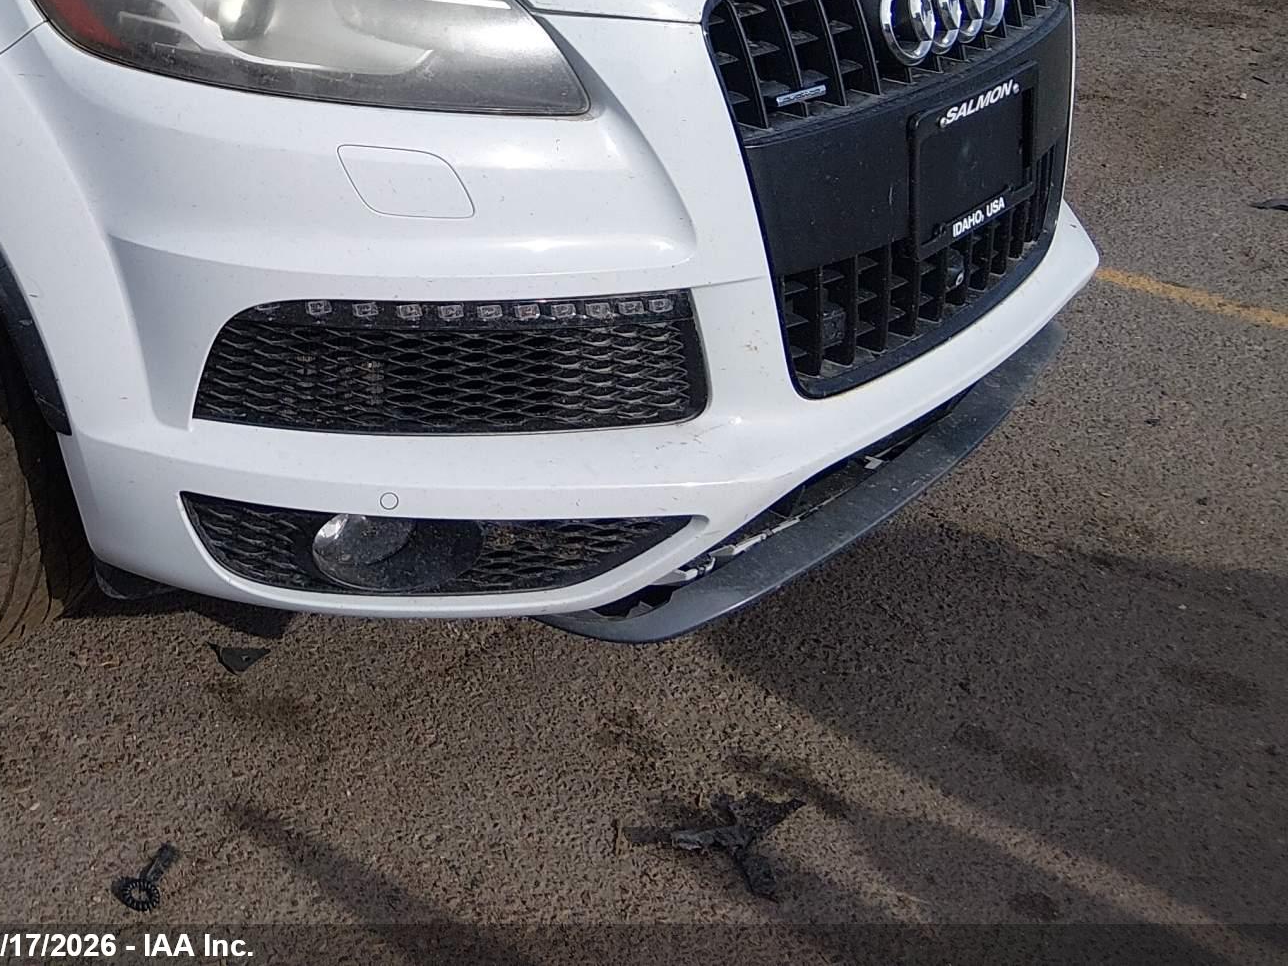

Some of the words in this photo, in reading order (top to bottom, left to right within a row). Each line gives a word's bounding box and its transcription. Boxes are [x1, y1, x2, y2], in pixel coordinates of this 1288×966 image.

[945, 79, 1013, 124] SALMON
[952, 208, 985, 238] IDAHO,
[985, 196, 1005, 218] USA
